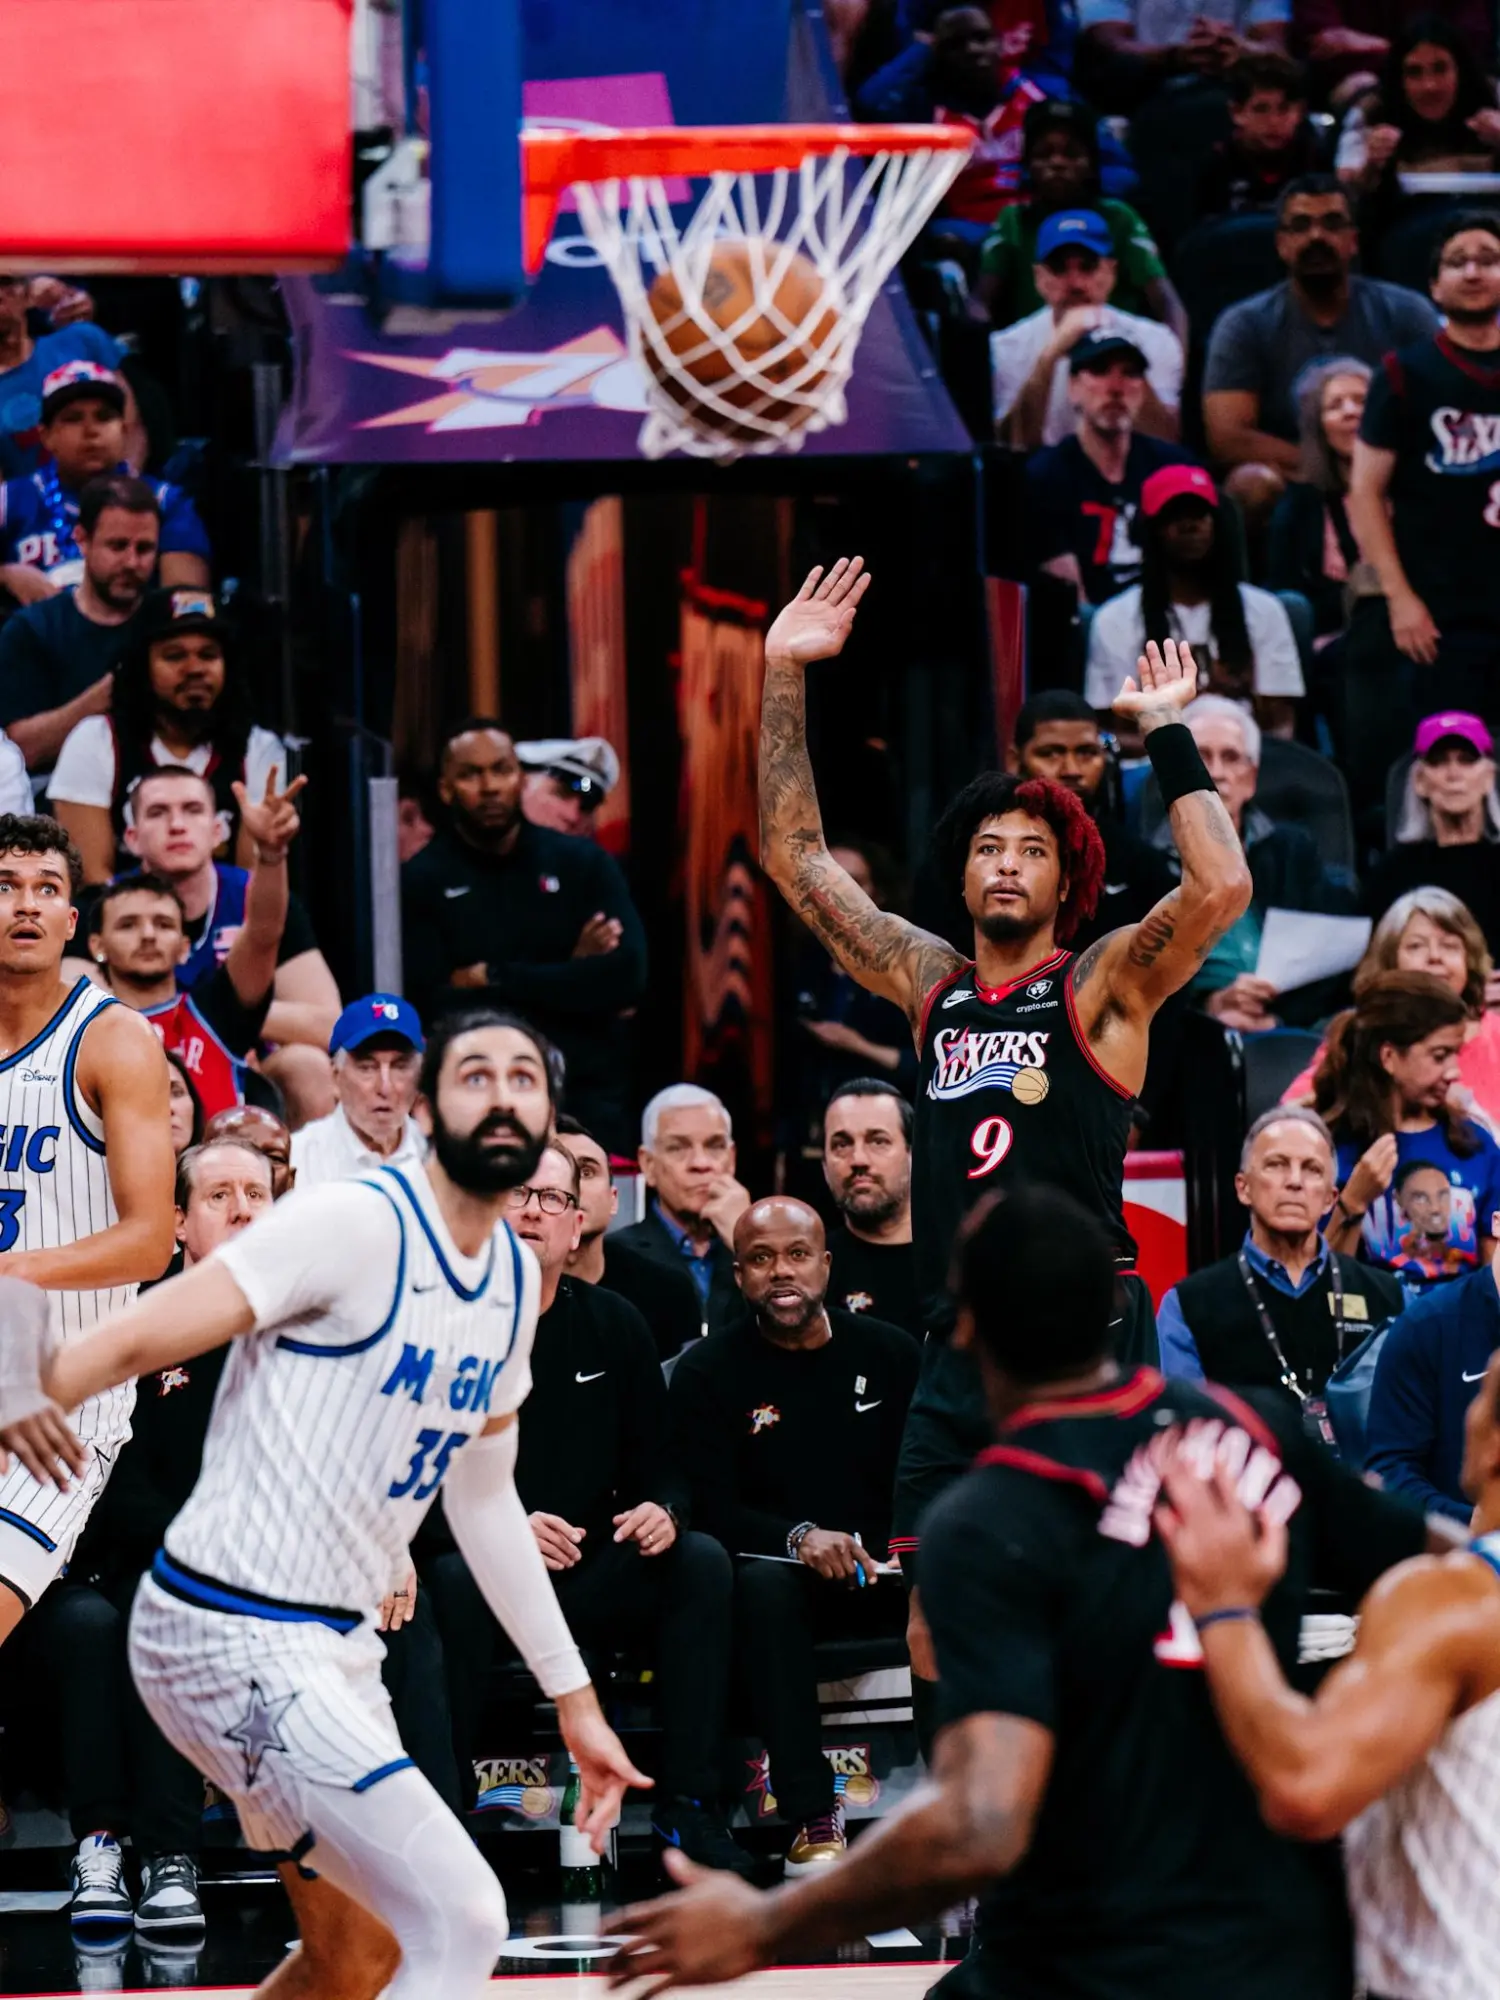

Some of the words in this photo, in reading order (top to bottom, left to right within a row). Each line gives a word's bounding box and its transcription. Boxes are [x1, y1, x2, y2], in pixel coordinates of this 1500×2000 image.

[1016, 1000, 1058, 1013] crypto.com
[0, 1124, 61, 1174] IC
[967, 1115, 1014, 1180] 9
[388, 1428, 470, 1501] 35
[822, 1747, 868, 1776] RS
